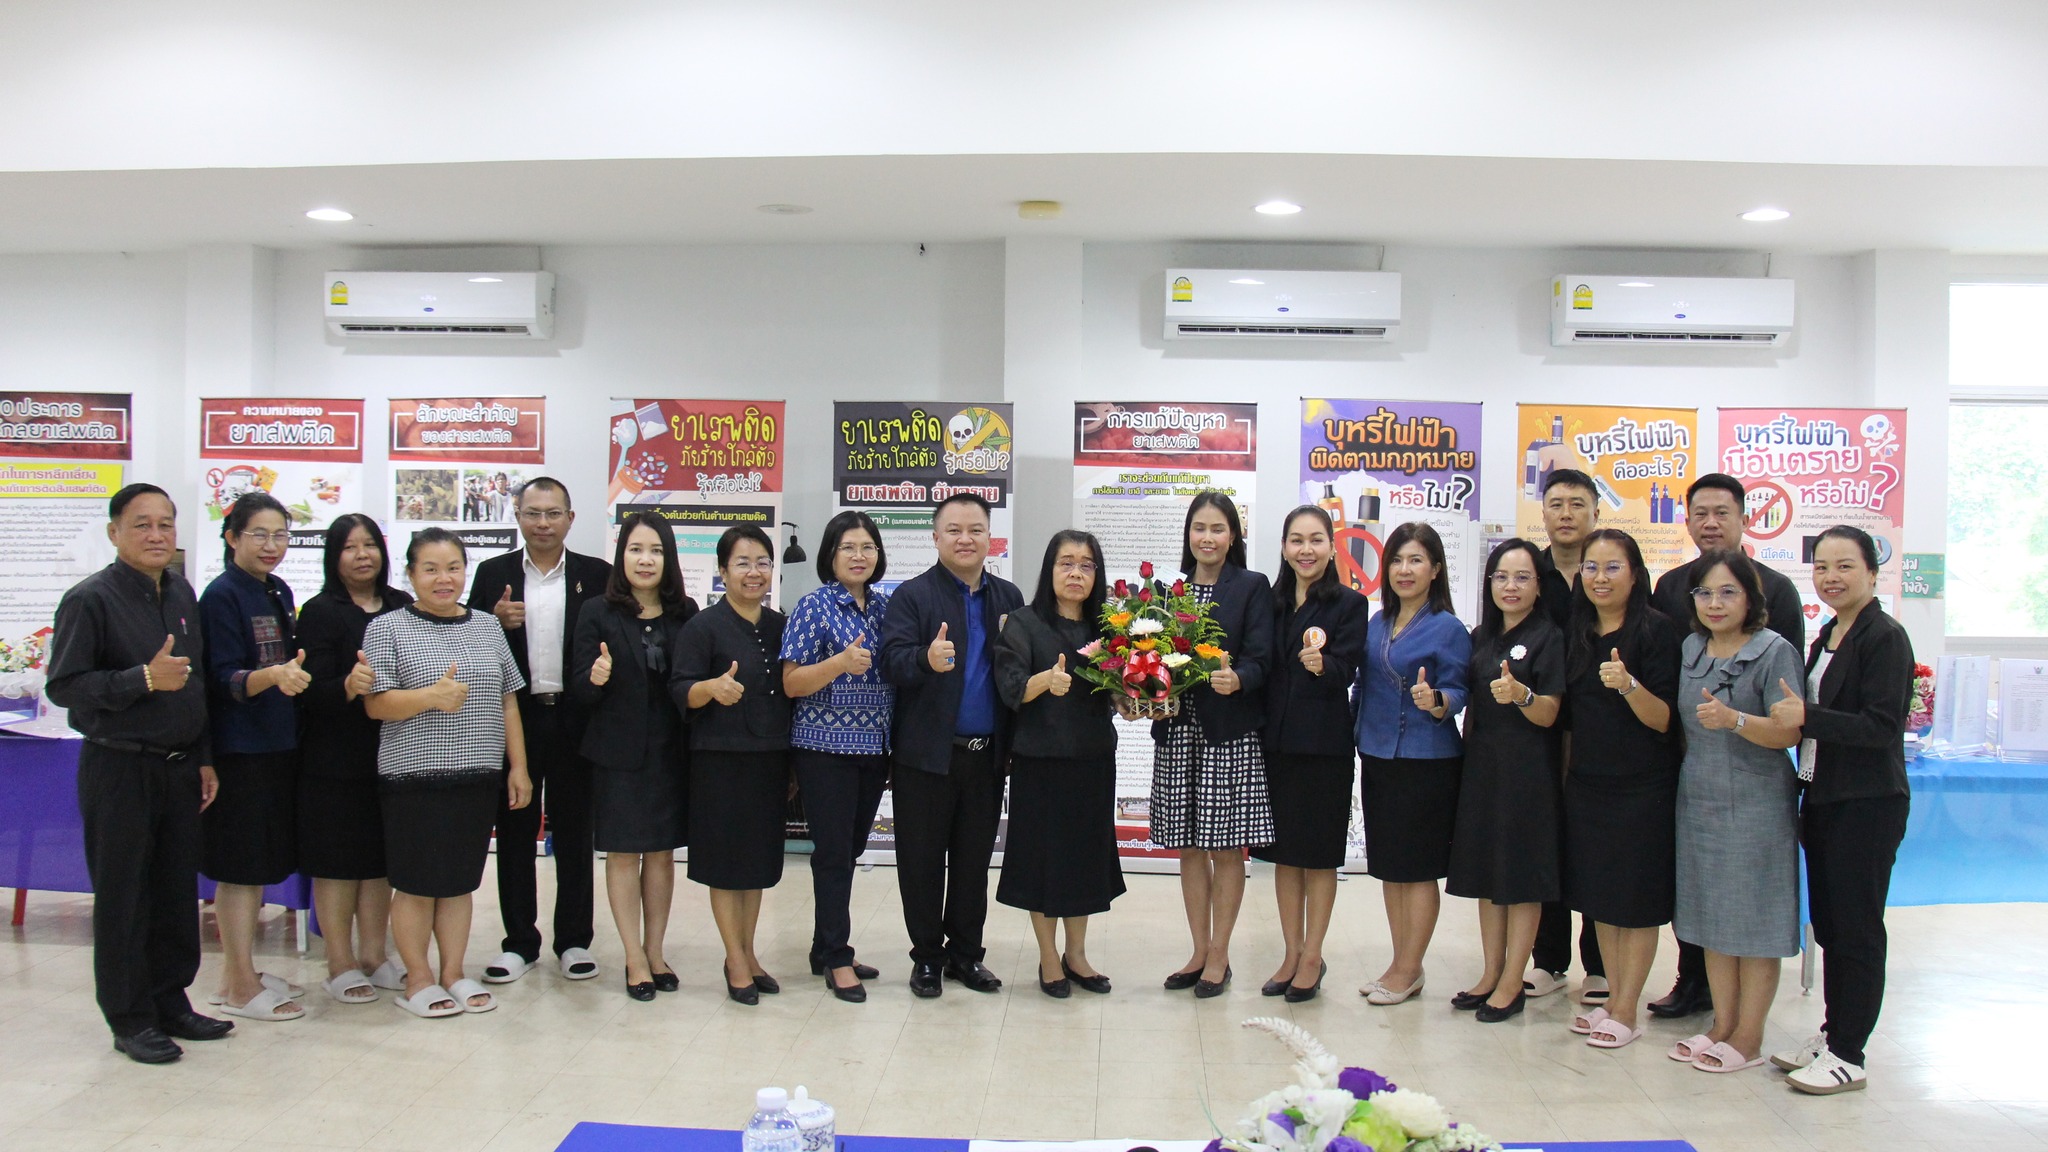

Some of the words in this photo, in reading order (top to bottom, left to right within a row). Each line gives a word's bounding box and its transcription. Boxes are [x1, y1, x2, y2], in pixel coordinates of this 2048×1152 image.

[17, 398, 83, 417] ประการ
[243, 406, 323, 416] ความหมายของ
[416, 402, 518, 426] ลักษณะสำคัญ
[1107, 405, 1226, 432] การแก้ปัญหา
[0, 419, 118, 440] กลยาเสพติด
[230, 420, 335, 444] ยาเสพติด
[422, 428, 512, 443] ของสารเสพติด
[671, 407, 775, 442] ยาเสพติด
[842, 409, 942, 445] ยาเสพติด
[1325, 407, 1456, 449] บุหรี่ไฟฟ้า
[1735, 414, 1849, 450] บุหรี่ไฟฟ้า
[1133, 434, 1199, 449] ยาเสพติด
[1576, 418, 1690, 462] บุหรี่ไฟฟ้า
[0, 466, 97, 480] กในการหลีกเลี่ยง
[1310, 447, 1474, 474] ผิดตามกฎหมาย
[1614, 453, 1688, 480] คืออะไร?
[1724, 447, 1862, 477] มีอันตราย
[696, 472, 763, 501] รู้หรือไม่?
[847, 480, 926, 502] ยาเสพติด
[1390, 476, 1473, 511] หรือไม่?
[1800, 463, 1899, 510] หรือไม่?
[1761, 547, 1794, 559] นิโคติน
[1901, 575, 1930, 595] างอิง
